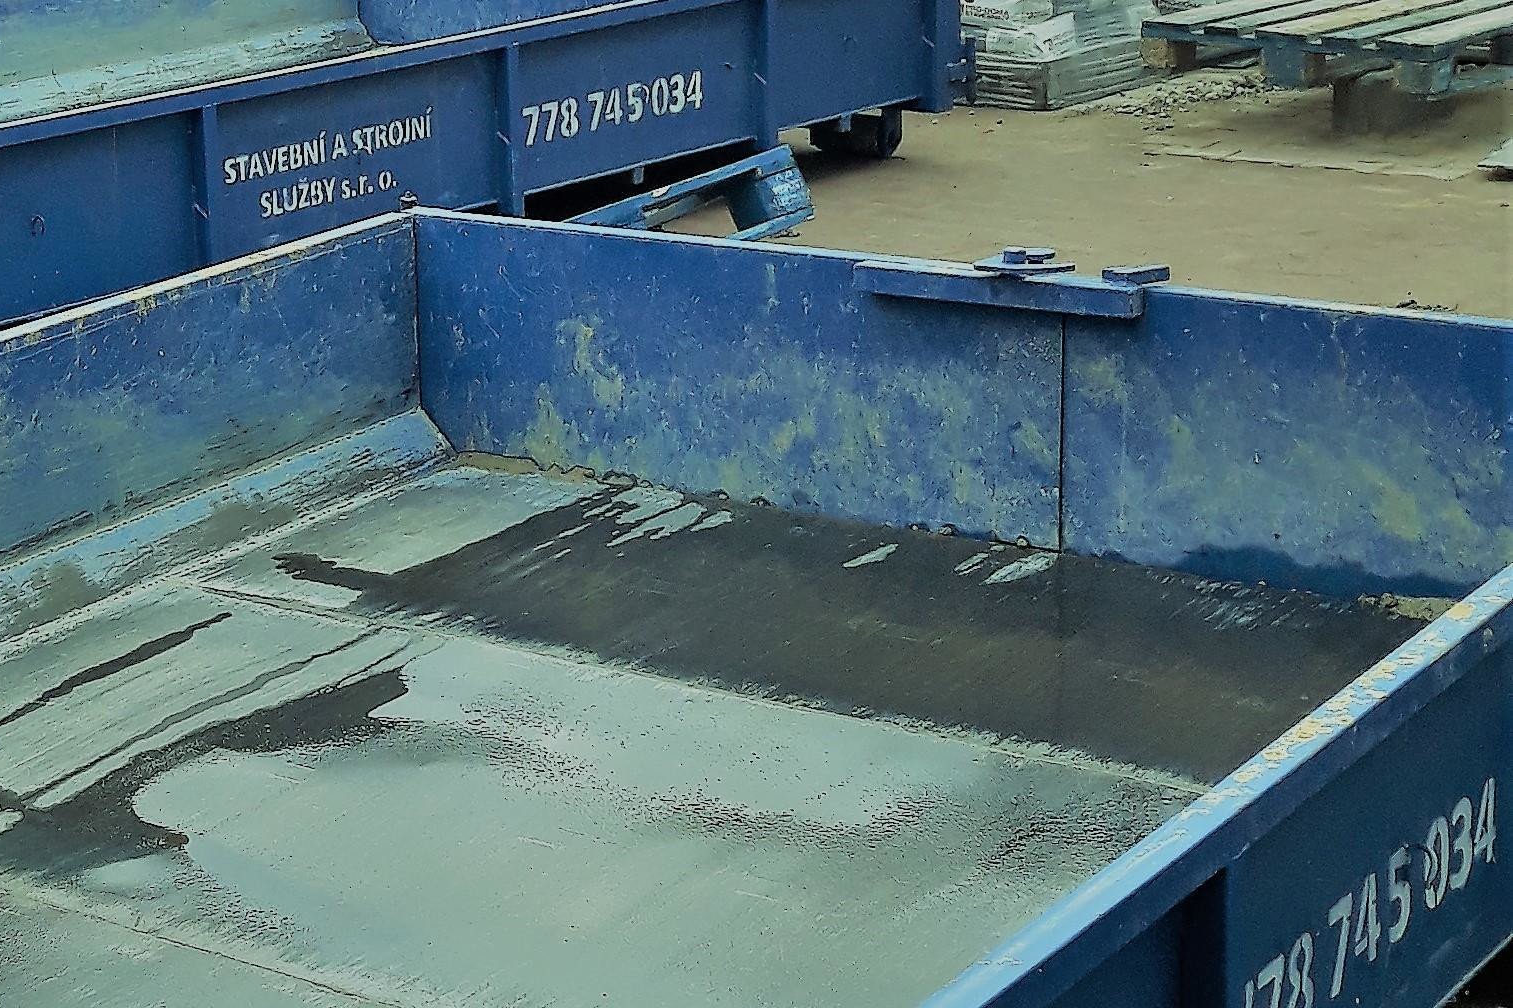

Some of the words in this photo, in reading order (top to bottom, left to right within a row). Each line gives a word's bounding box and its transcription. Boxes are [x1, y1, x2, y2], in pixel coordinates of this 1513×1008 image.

[223, 130, 327, 185] STAVEBNÍ
[331, 132, 349, 161] A
[351, 105, 433, 155] STROJNÍ
[521, 96, 580, 148] 778
[587, 82, 645, 132] 745
[651, 69, 704, 117] 034
[260, 176, 336, 219] SLUŽBY
[1244, 931, 1315, 1008] 78
[1327, 843, 1412, 1000] 745
[1422, 776, 1497, 909] 034
